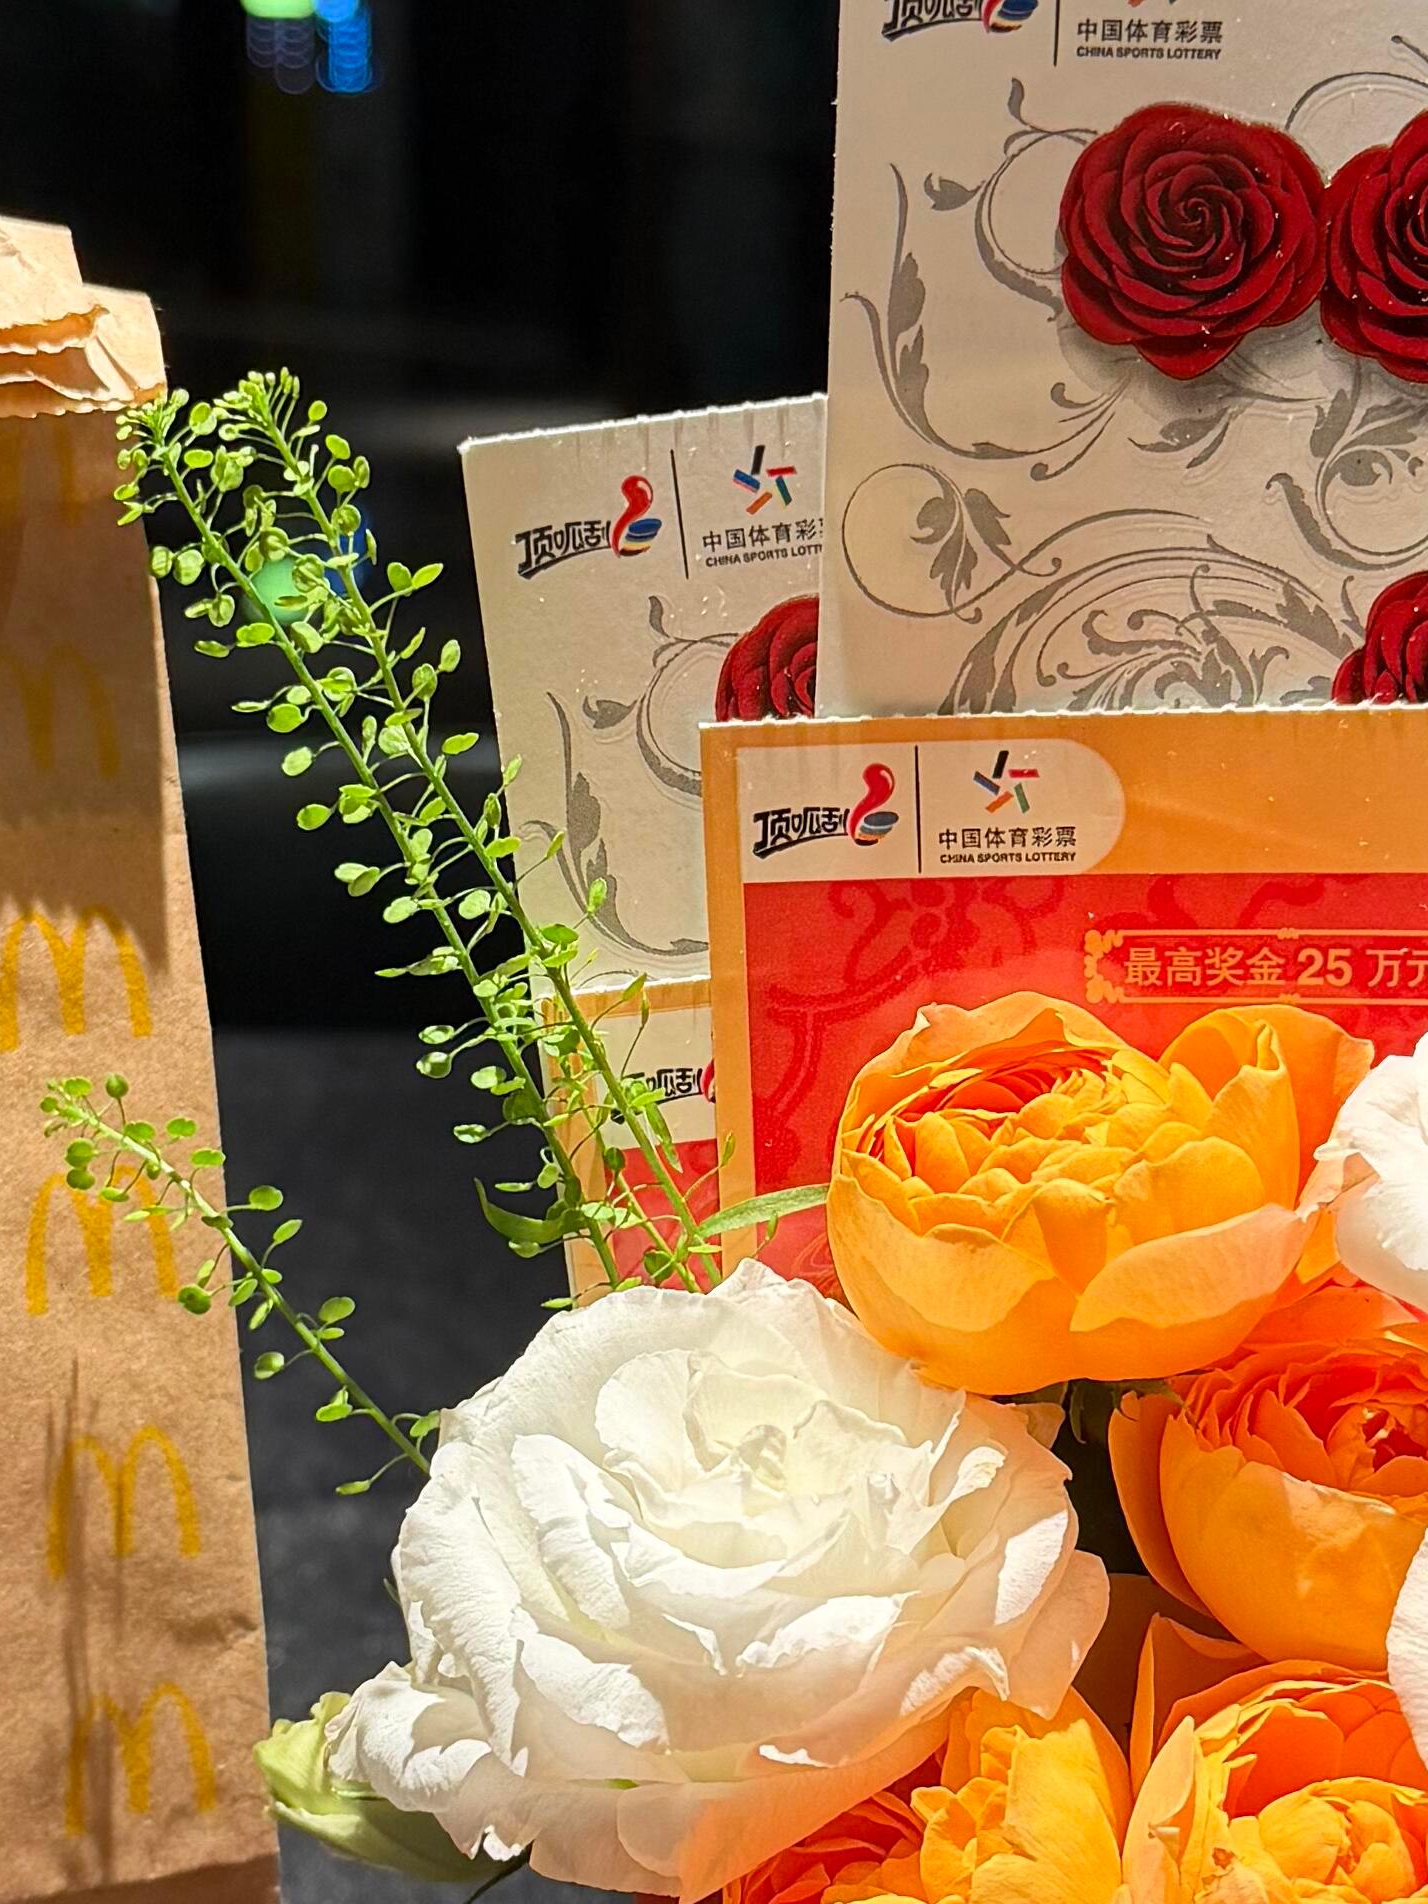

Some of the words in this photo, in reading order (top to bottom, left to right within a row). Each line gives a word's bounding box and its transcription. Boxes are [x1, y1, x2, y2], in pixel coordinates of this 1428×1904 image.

[1077, 18, 1224, 44] 中国体育彩票
[1076, 46, 1113, 59] CHINA
[1116, 46, 1164, 59] SPORTS
[1167, 47, 1221, 60] LOTTERY
[702, 517, 823, 554] 中国体育彩
[705, 554, 741, 568] CHINA
[743, 548, 789, 564] SPORTS
[938, 826, 1077, 850] 中国体育彩票
[940, 853, 975, 864] CHINA
[977, 852, 1022, 863] SPORTS
[1025, 851, 1076, 862] LOTTERY
